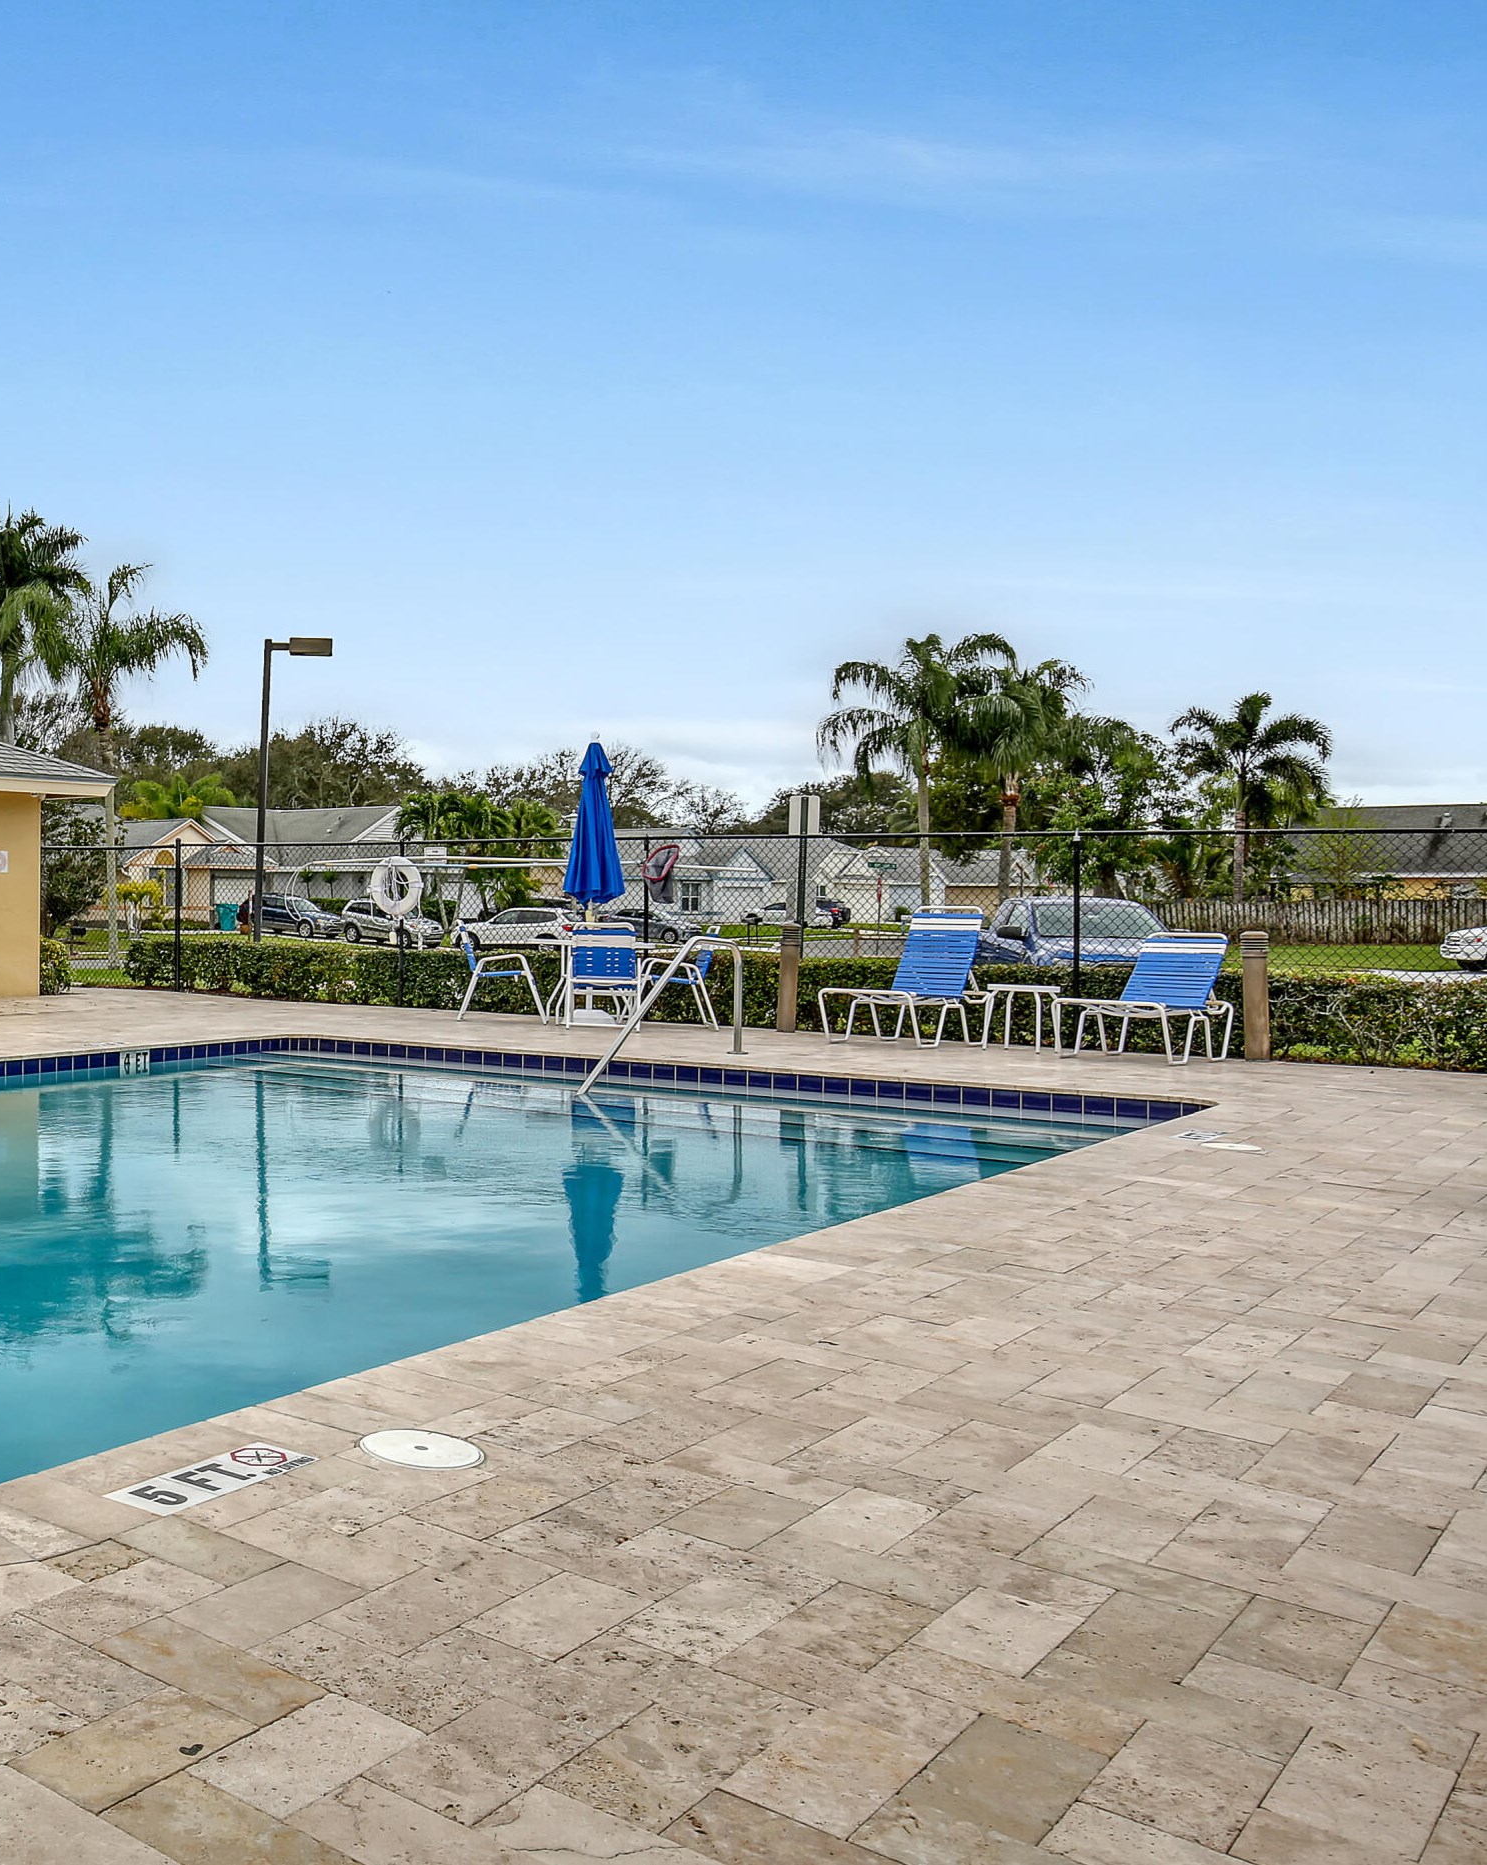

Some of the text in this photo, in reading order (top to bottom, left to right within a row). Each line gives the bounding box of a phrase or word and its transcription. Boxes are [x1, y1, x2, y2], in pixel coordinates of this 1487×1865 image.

[262, 1456, 316, 1476] NO DIVING
[127, 1462, 257, 1506] 5 FT.
